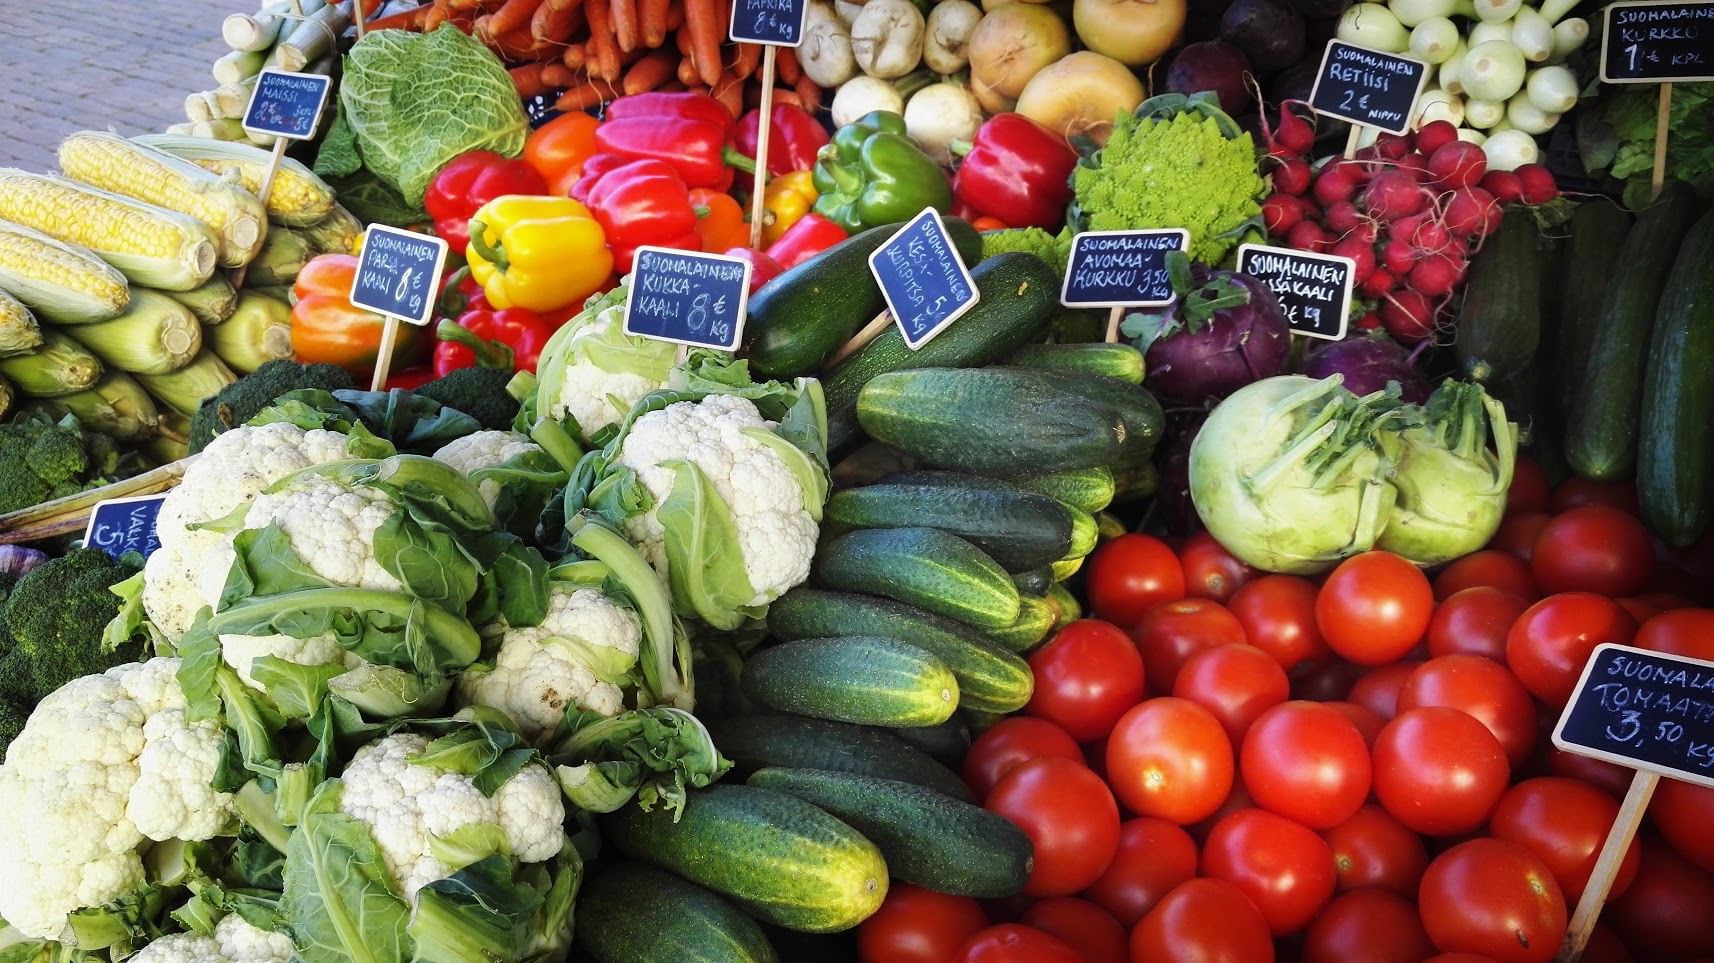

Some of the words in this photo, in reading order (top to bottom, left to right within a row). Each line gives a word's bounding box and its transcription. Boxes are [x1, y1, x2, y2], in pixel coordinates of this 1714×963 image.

[753, 11, 766, 33] 8
[1622, 26, 1698, 41] KURKKU
[1336, 48, 1413, 76] SUOMALAINEN
[262, 87, 298, 103] MAISSI
[263, 75, 319, 92] SUOMALAINEN
[1368, 109, 1401, 121] NIPPU
[371, 233, 436, 261] SUOMALAINEN
[1080, 237, 1179, 252] SUOMALAINEN
[640, 252, 744, 281] SUOMALAINEN
[922, 220, 968, 302] SUOMALAINEN
[1248, 254, 1345, 285] SUOMALAINEN
[362, 270, 391, 295] KAALI
[886, 245, 924, 307] KURPITSA
[1073, 269, 1137, 289] KURKKU
[638, 295, 680, 318] KAALI
